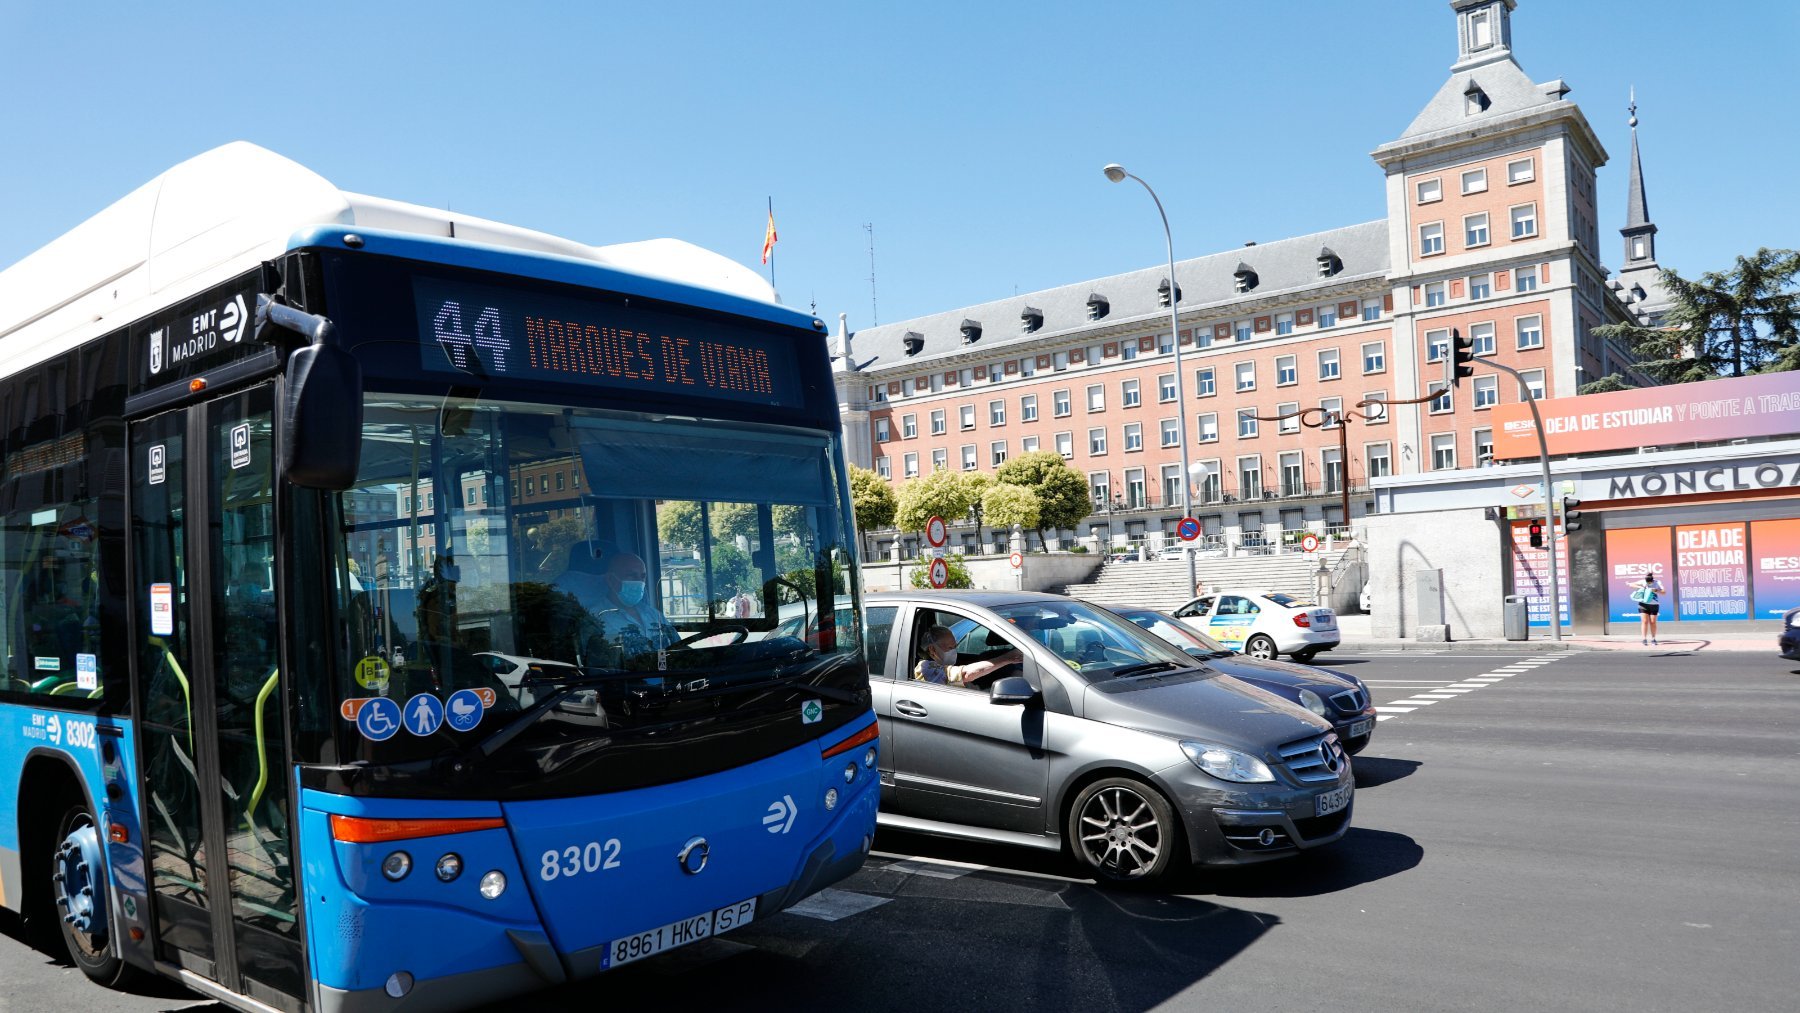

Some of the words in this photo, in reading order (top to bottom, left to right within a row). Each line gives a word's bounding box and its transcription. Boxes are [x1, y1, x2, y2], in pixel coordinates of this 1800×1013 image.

[192, 309, 217, 335] EMT
[173, 331, 217, 363] MADRID
[433, 301, 511, 372] 44
[526, 316, 655, 380] MARQUES
[661, 335, 695, 385] DE
[1546, 416, 1579, 434] DEJA
[1582, 414, 1600, 431] DE
[1603, 407, 1673, 429] ESTUDIAR
[1674, 404, 1687, 421] Y
[1690, 399, 1741, 420] PONTE
[1743, 397, 1756, 415] A
[1678, 529, 1719, 549] DEJA
[1720, 528, 1744, 547] DE
[1679, 550, 1745, 567] ESTUDIAR
[1627, 563, 1663, 575] ESIC
[1680, 569, 1689, 584] Y
[1689, 568, 1733, 584] PONTE
[1734, 567, 1745, 583] A
[1680, 586, 1731, 599] TRABAJAR
[1681, 601, 1697, 615] TU
[1698, 600, 1746, 615] FUTURO
[483, 691, 492, 703] 2
[347, 702, 354, 714] 1
[32, 714, 45, 727] EMT
[22, 725, 46, 740] MADRID
[66, 720, 96, 749] 8302
[540, 838, 622, 881] 8302
[616, 929, 664, 962] 8961
[671, 916, 706, 946] HKC
